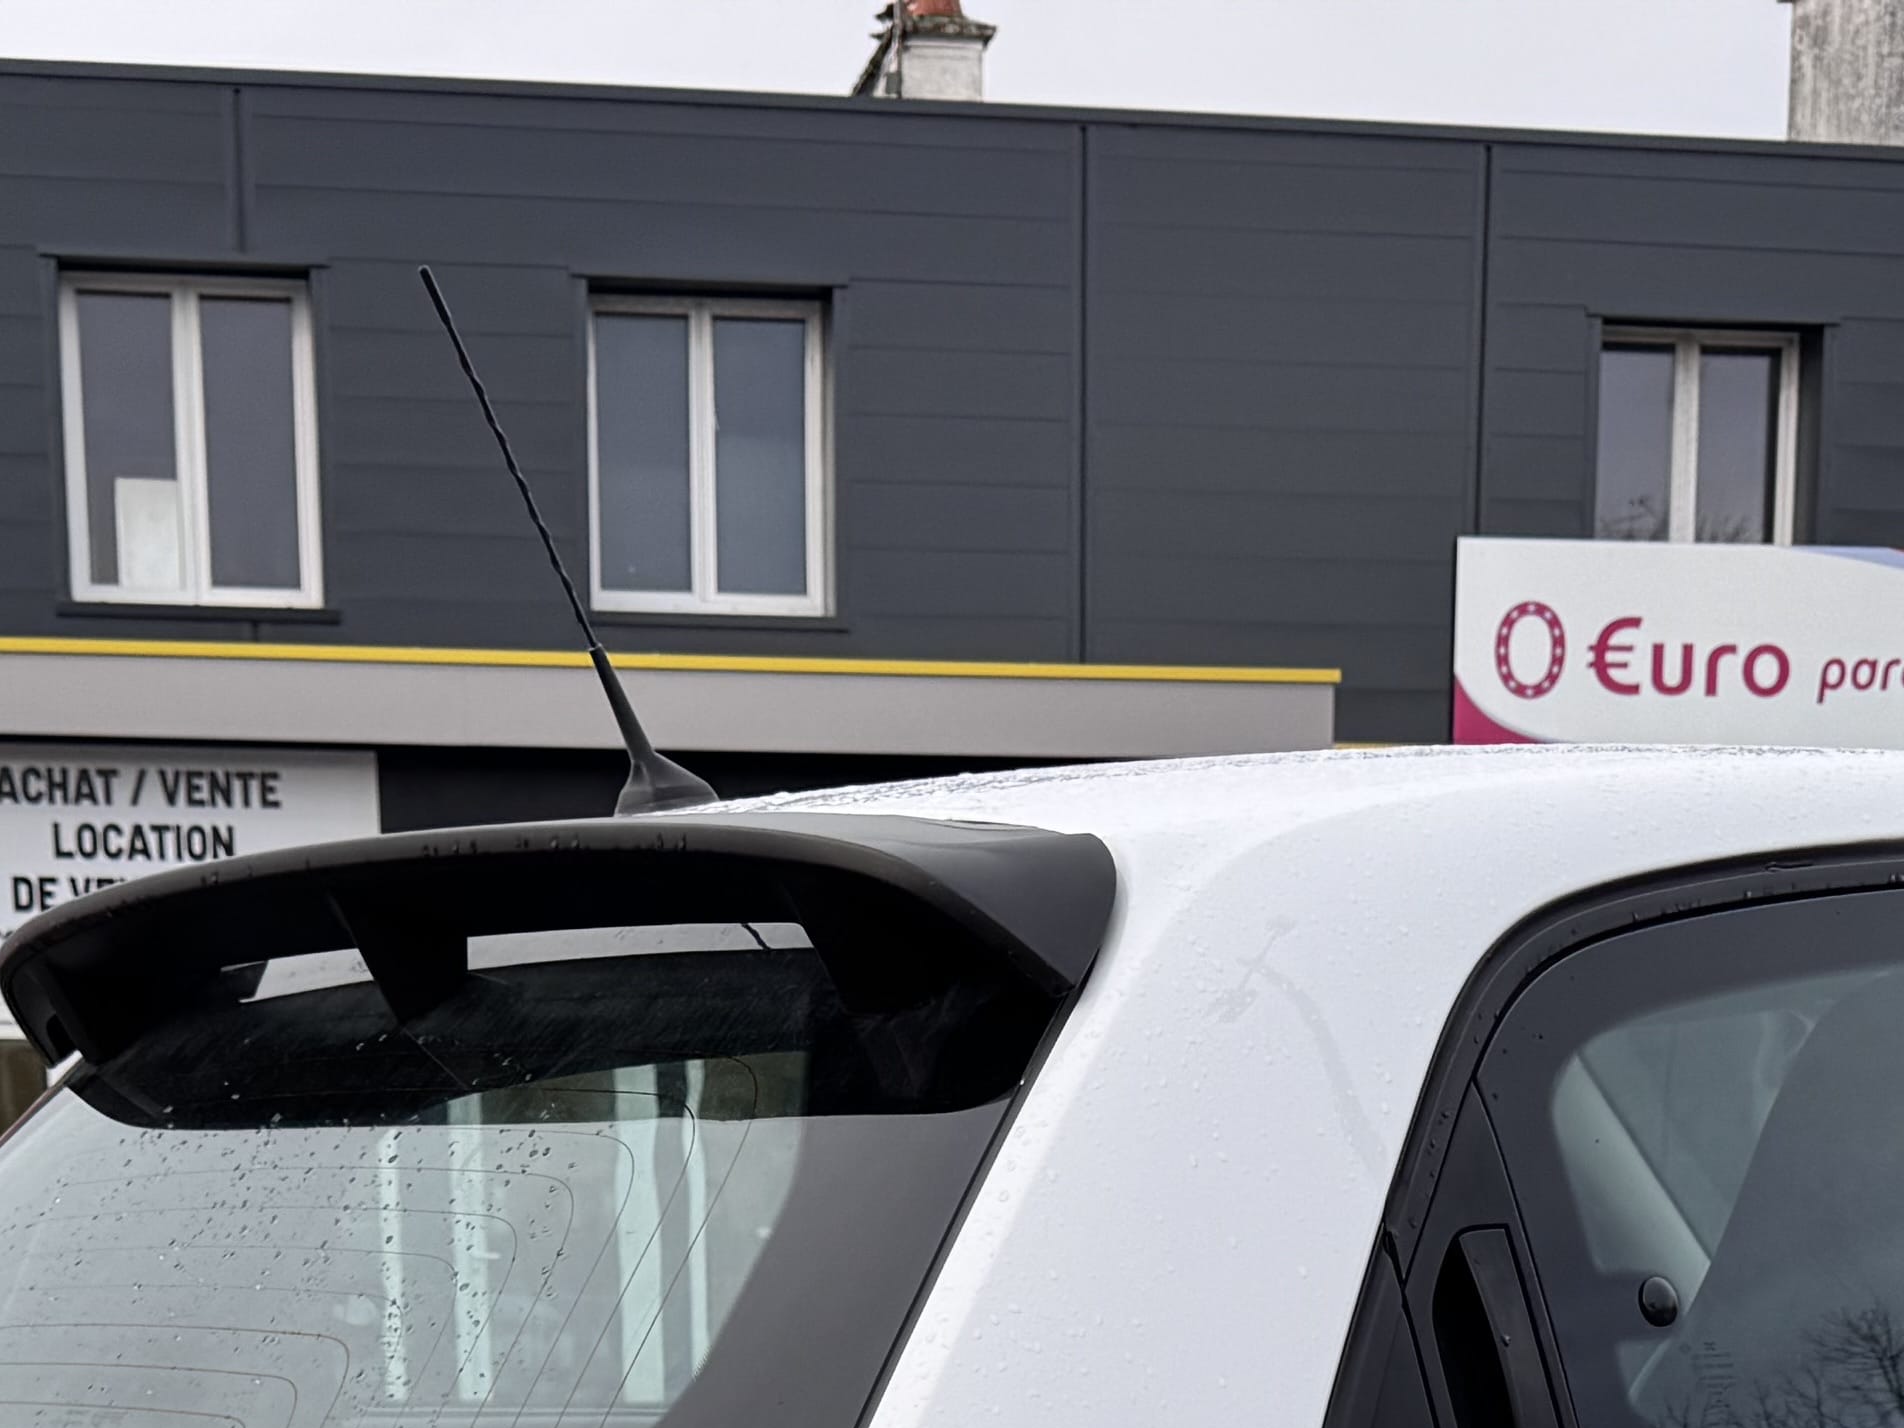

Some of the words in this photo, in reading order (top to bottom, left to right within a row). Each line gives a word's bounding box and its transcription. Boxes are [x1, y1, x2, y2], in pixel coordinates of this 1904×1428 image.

[1495, 600, 1566, 699] 0
[1587, 616, 1791, 698] €uro
[156, 770, 283, 809] VENTE
[52, 822, 236, 862] LOCATION
[12, 876, 58, 912] DE
